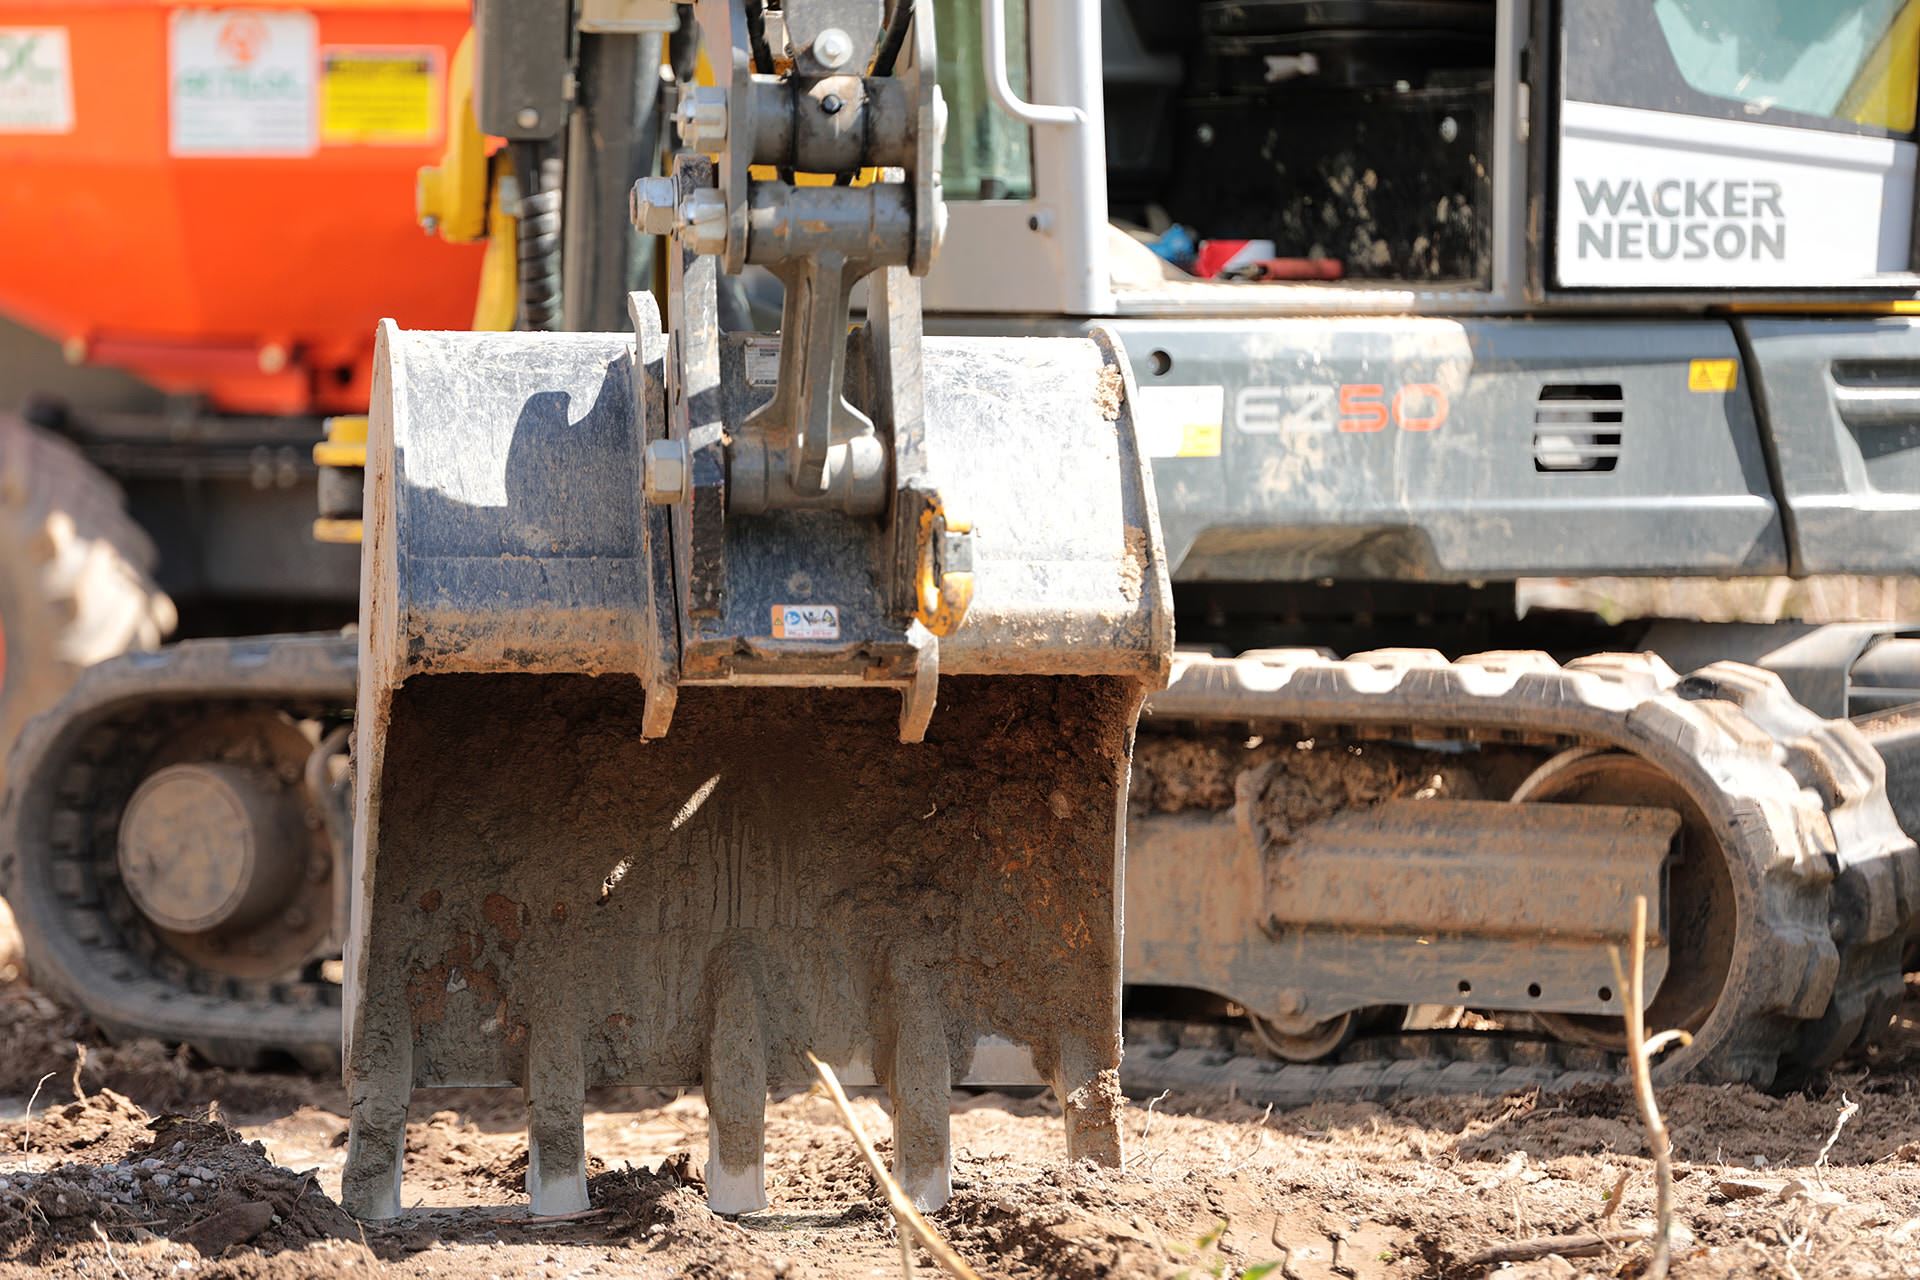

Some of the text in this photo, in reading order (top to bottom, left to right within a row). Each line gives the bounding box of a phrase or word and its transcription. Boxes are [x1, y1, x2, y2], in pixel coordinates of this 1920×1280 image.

[1574, 179, 1785, 218] WACKER
[1578, 223, 1786, 260] NEUSON
[1235, 383, 1450, 434] EZ50
